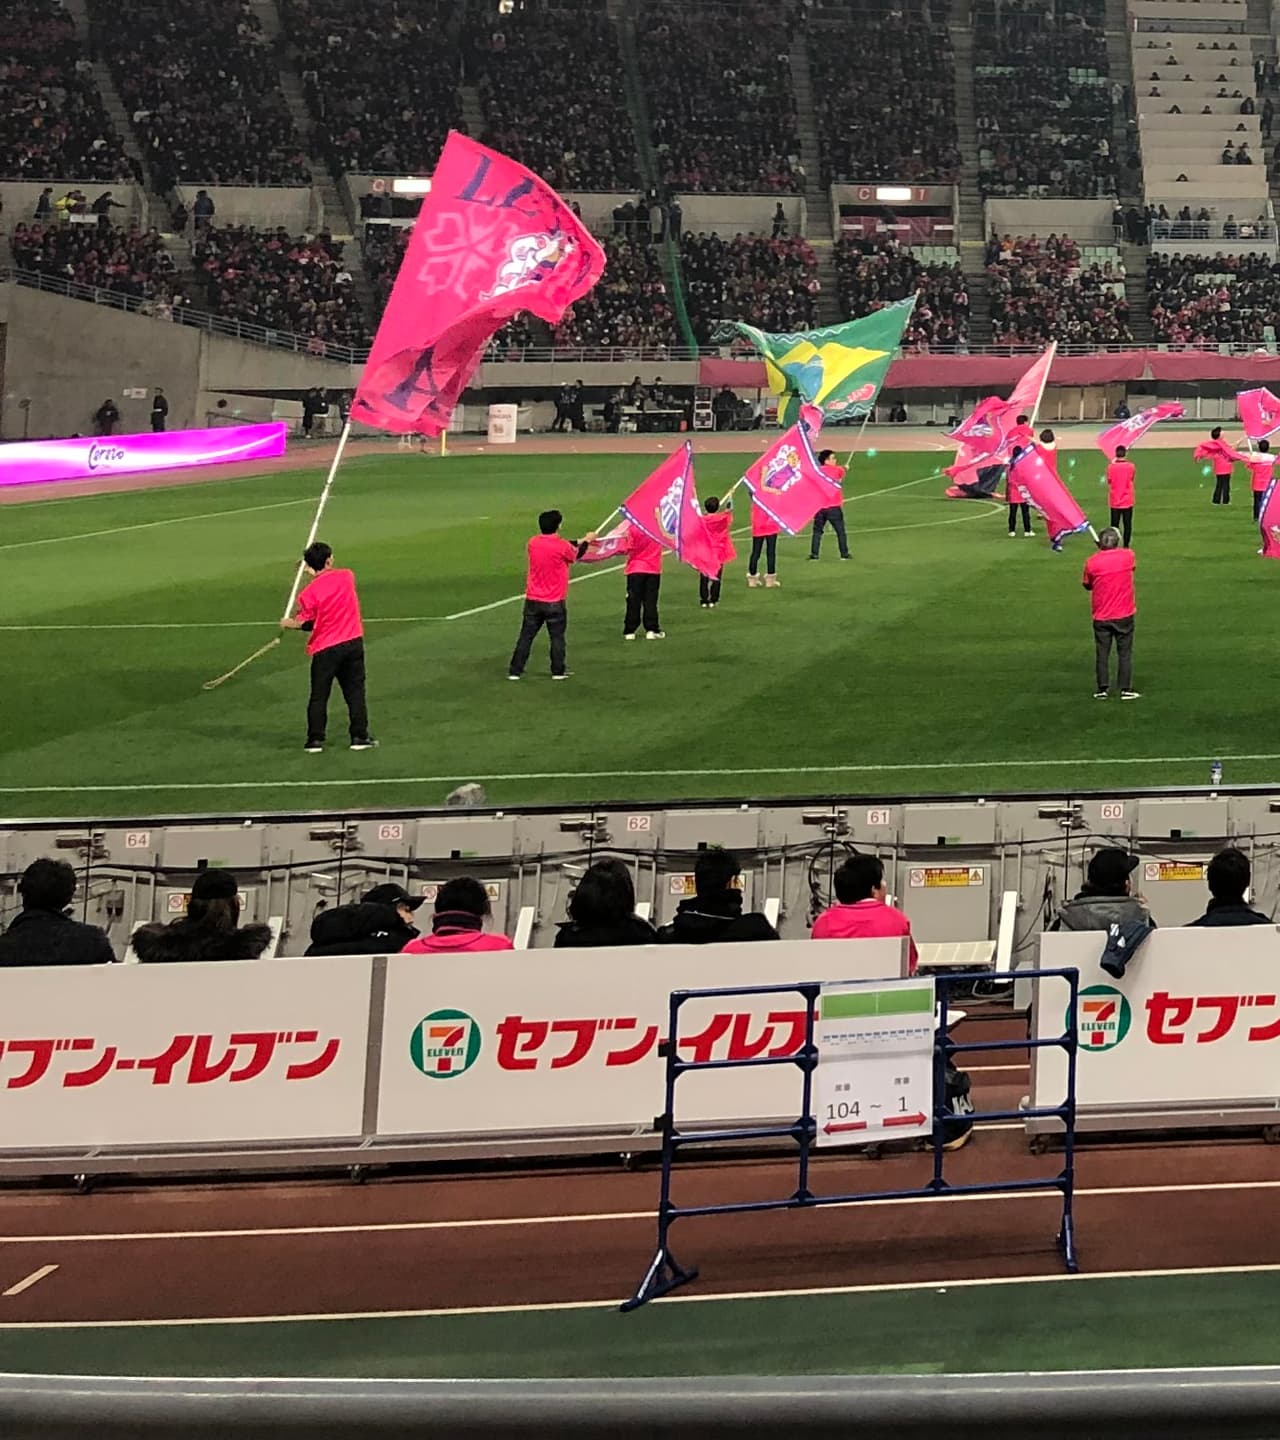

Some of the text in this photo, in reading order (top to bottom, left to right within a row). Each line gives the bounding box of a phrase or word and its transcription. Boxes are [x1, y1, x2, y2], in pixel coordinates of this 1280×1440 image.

[859, 188, 870, 200] C
[868, 810, 888, 824] 61
[1103, 805, 1122, 818] 60
[628, 817, 648, 830] 62
[380, 825, 400, 839] 63
[128, 834, 148, 847] 64
[0, 1032, 339, 1088] ブン-イレブン
[826, 1101, 861, 1120] 104
[898, 1096, 909, 1113] 1
